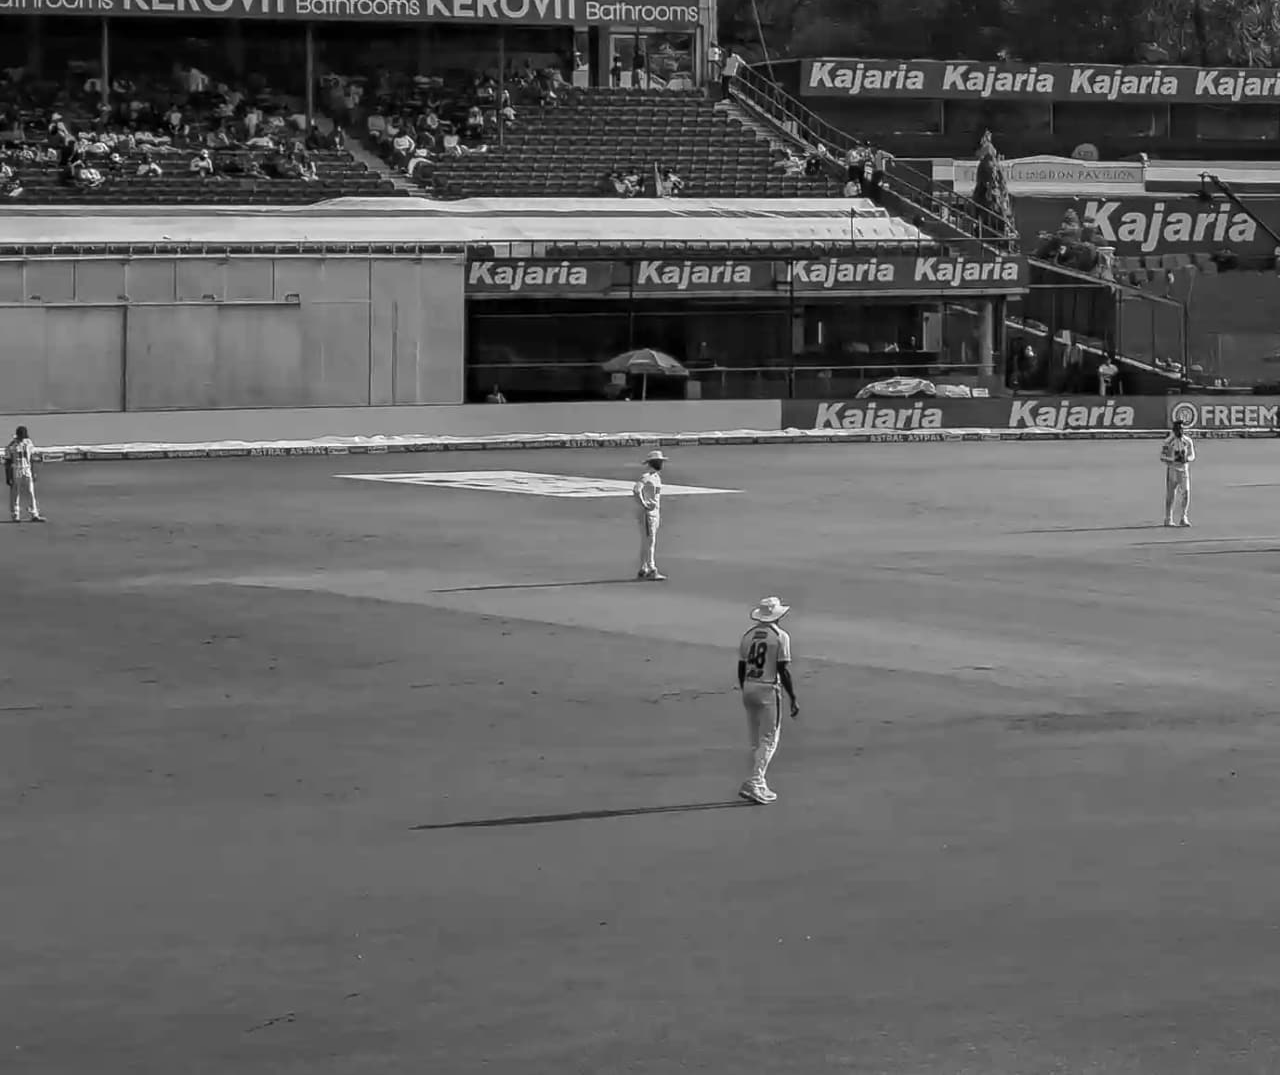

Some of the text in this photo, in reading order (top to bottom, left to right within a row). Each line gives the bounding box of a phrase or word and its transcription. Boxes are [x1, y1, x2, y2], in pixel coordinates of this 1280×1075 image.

[586, 2, 698, 23] Bathrooms
[810, 62, 924, 94] Kajaria
[943, 65, 1054, 97] Kajaria
[1070, 69, 1178, 100] Kajaria
[1083, 201, 1257, 252] Kajaria
[469, 258, 1018, 290] Kajaria Kajaria Kajaria Kajaria
[815, 400, 1135, 428] Kajaria Kajaria
